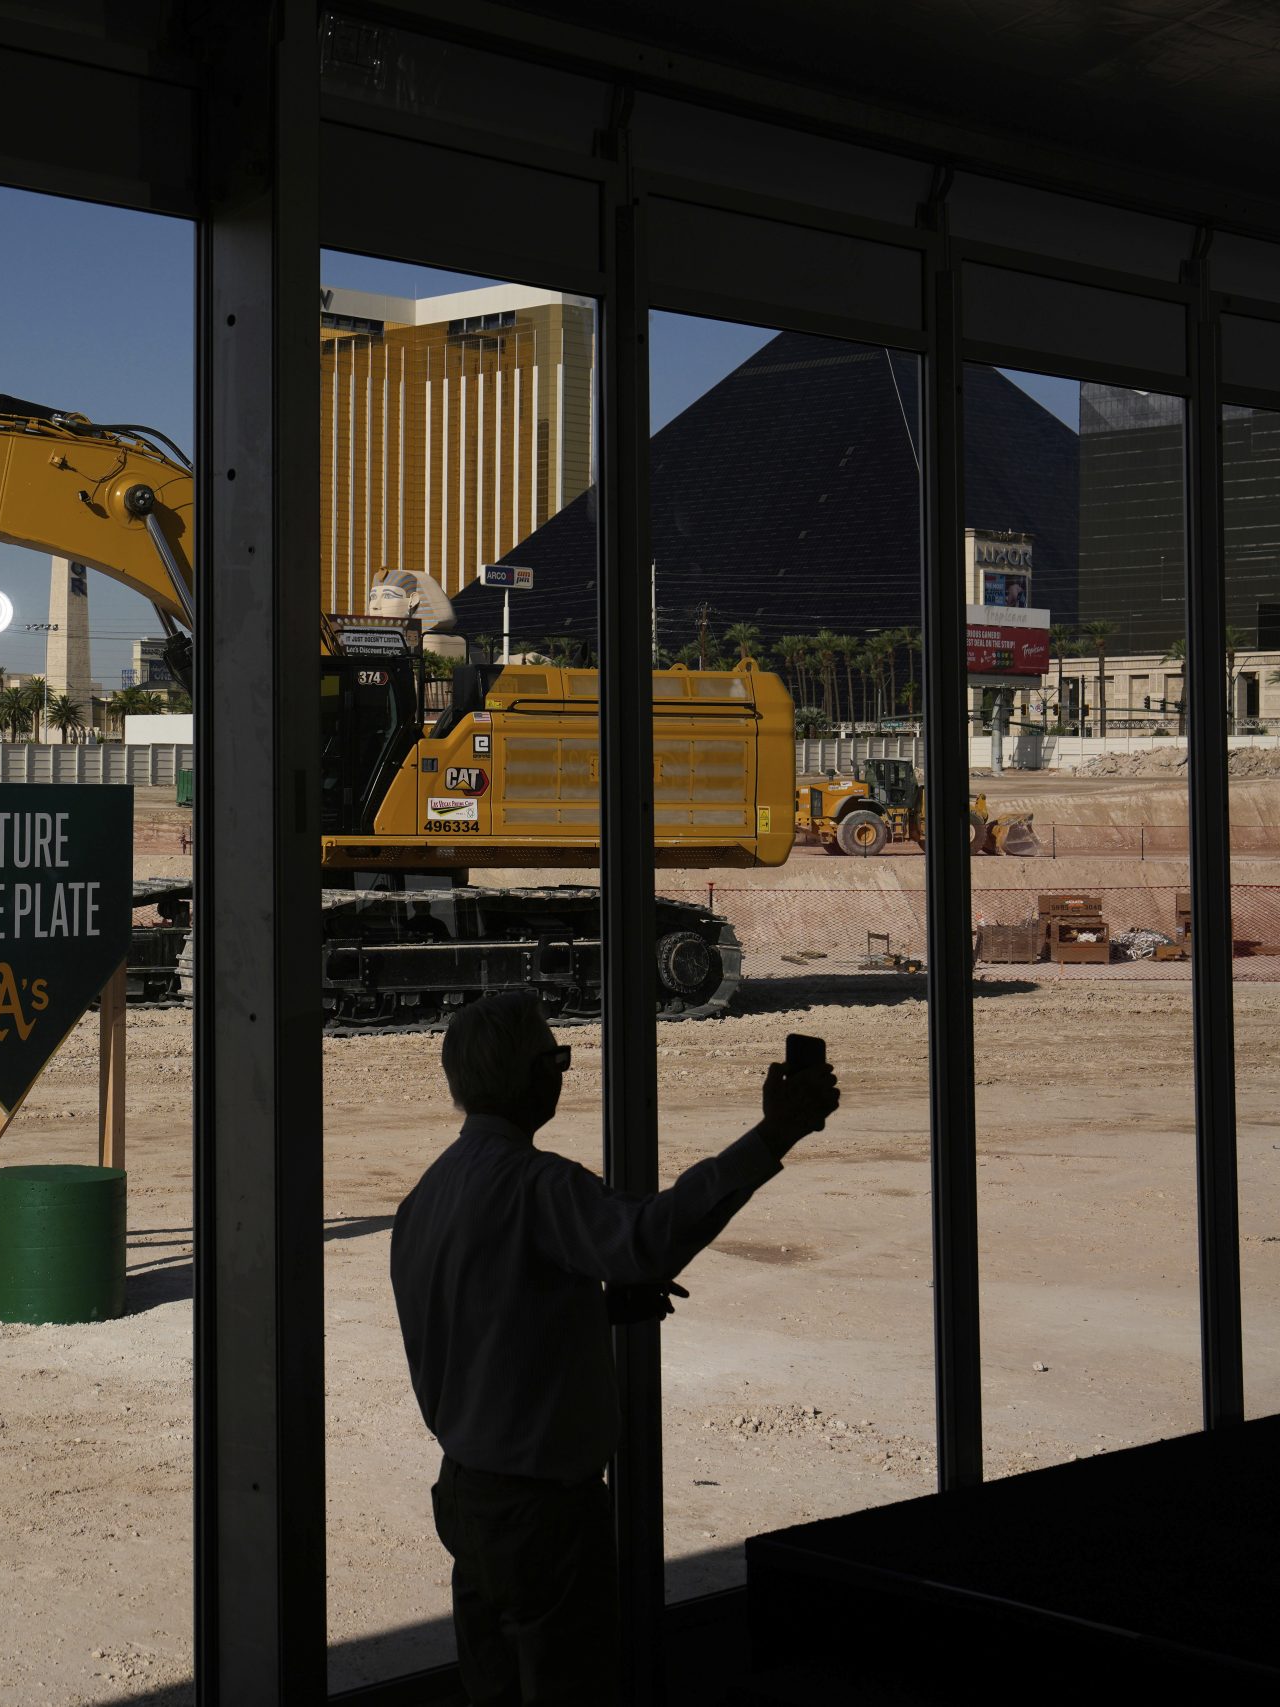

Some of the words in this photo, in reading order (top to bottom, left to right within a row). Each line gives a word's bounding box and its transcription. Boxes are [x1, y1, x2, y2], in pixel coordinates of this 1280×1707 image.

[975, 544, 1032, 567] LUXOR
[486, 571, 507, 581] ARCO
[359, 646, 382, 654] Discount
[359, 671, 381, 684] 374
[446, 768, 480, 790] CAT
[424, 820, 480, 833] 496334
[14, 882, 100, 939] PLATE
